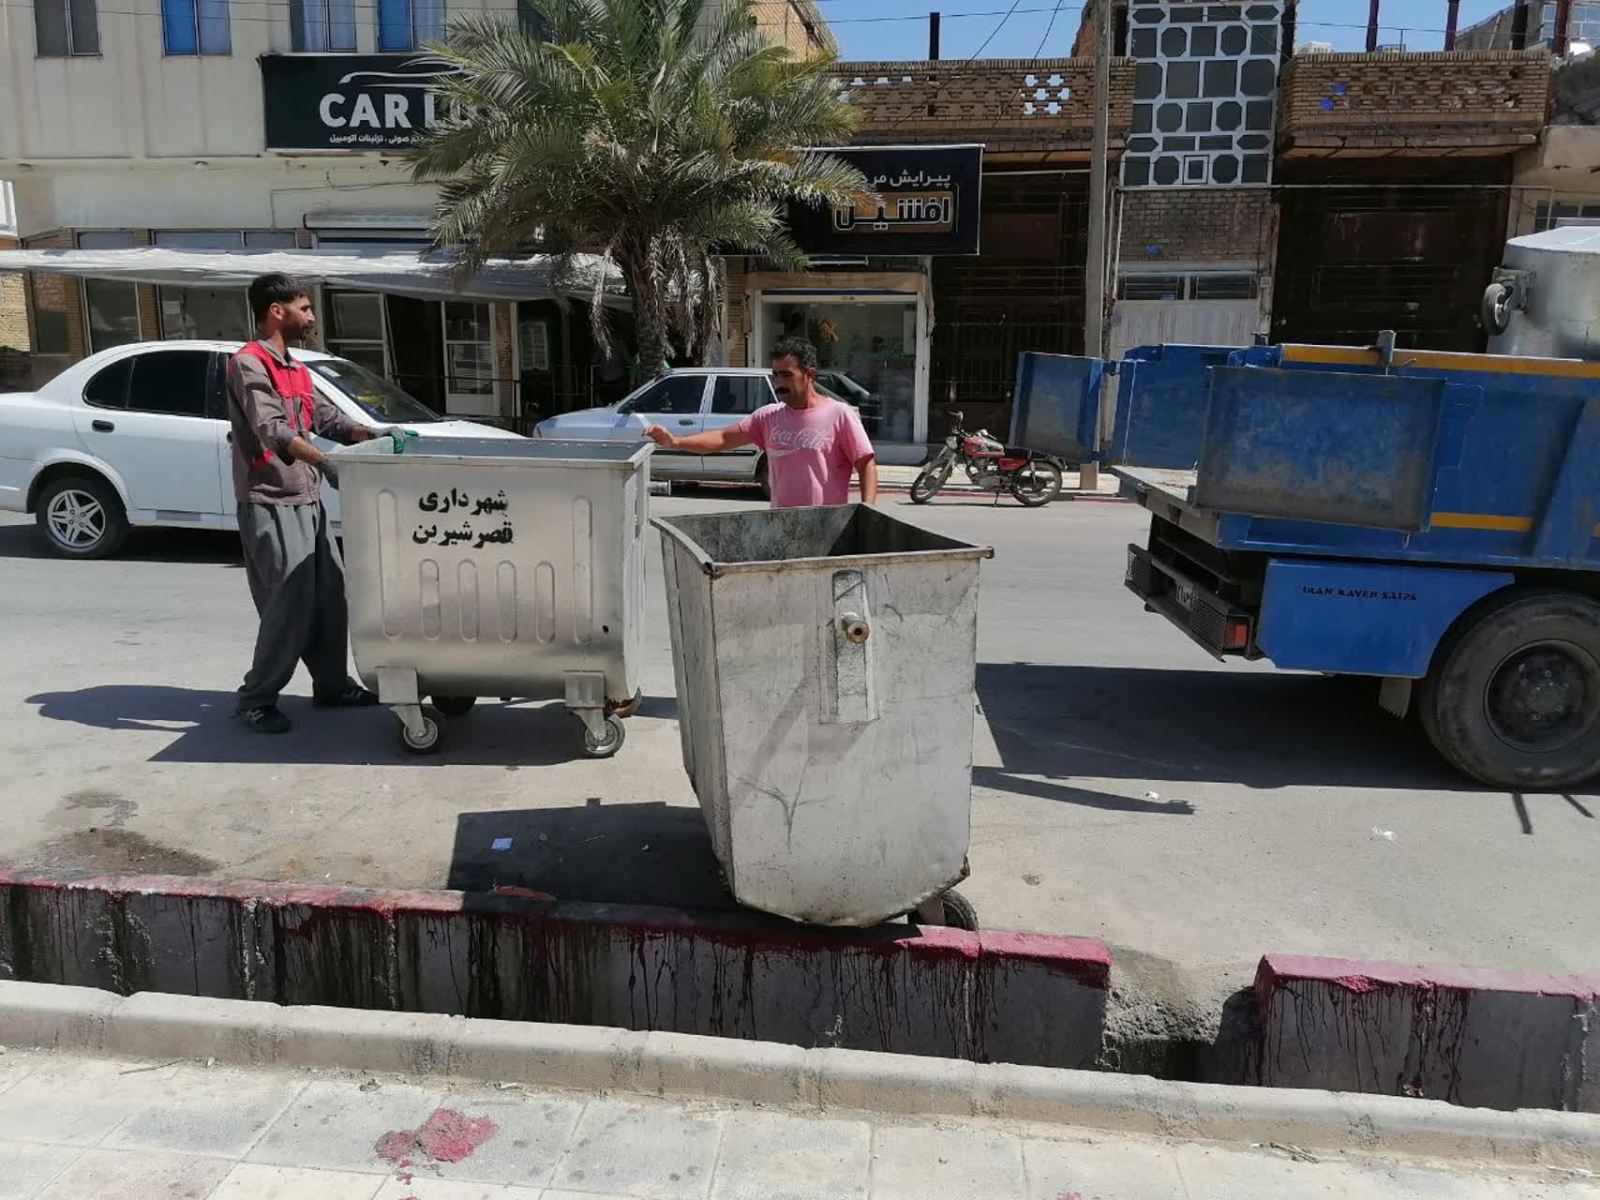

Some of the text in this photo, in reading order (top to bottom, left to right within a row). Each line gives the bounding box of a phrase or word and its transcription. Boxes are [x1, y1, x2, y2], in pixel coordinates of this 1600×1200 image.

[319, 93, 412, 128] CAR
[890, 169, 951, 189] پیرایش
[834, 196, 951, 231] افشین
[1302, 585, 1417, 601] IRAN KAVEH SAIPA
